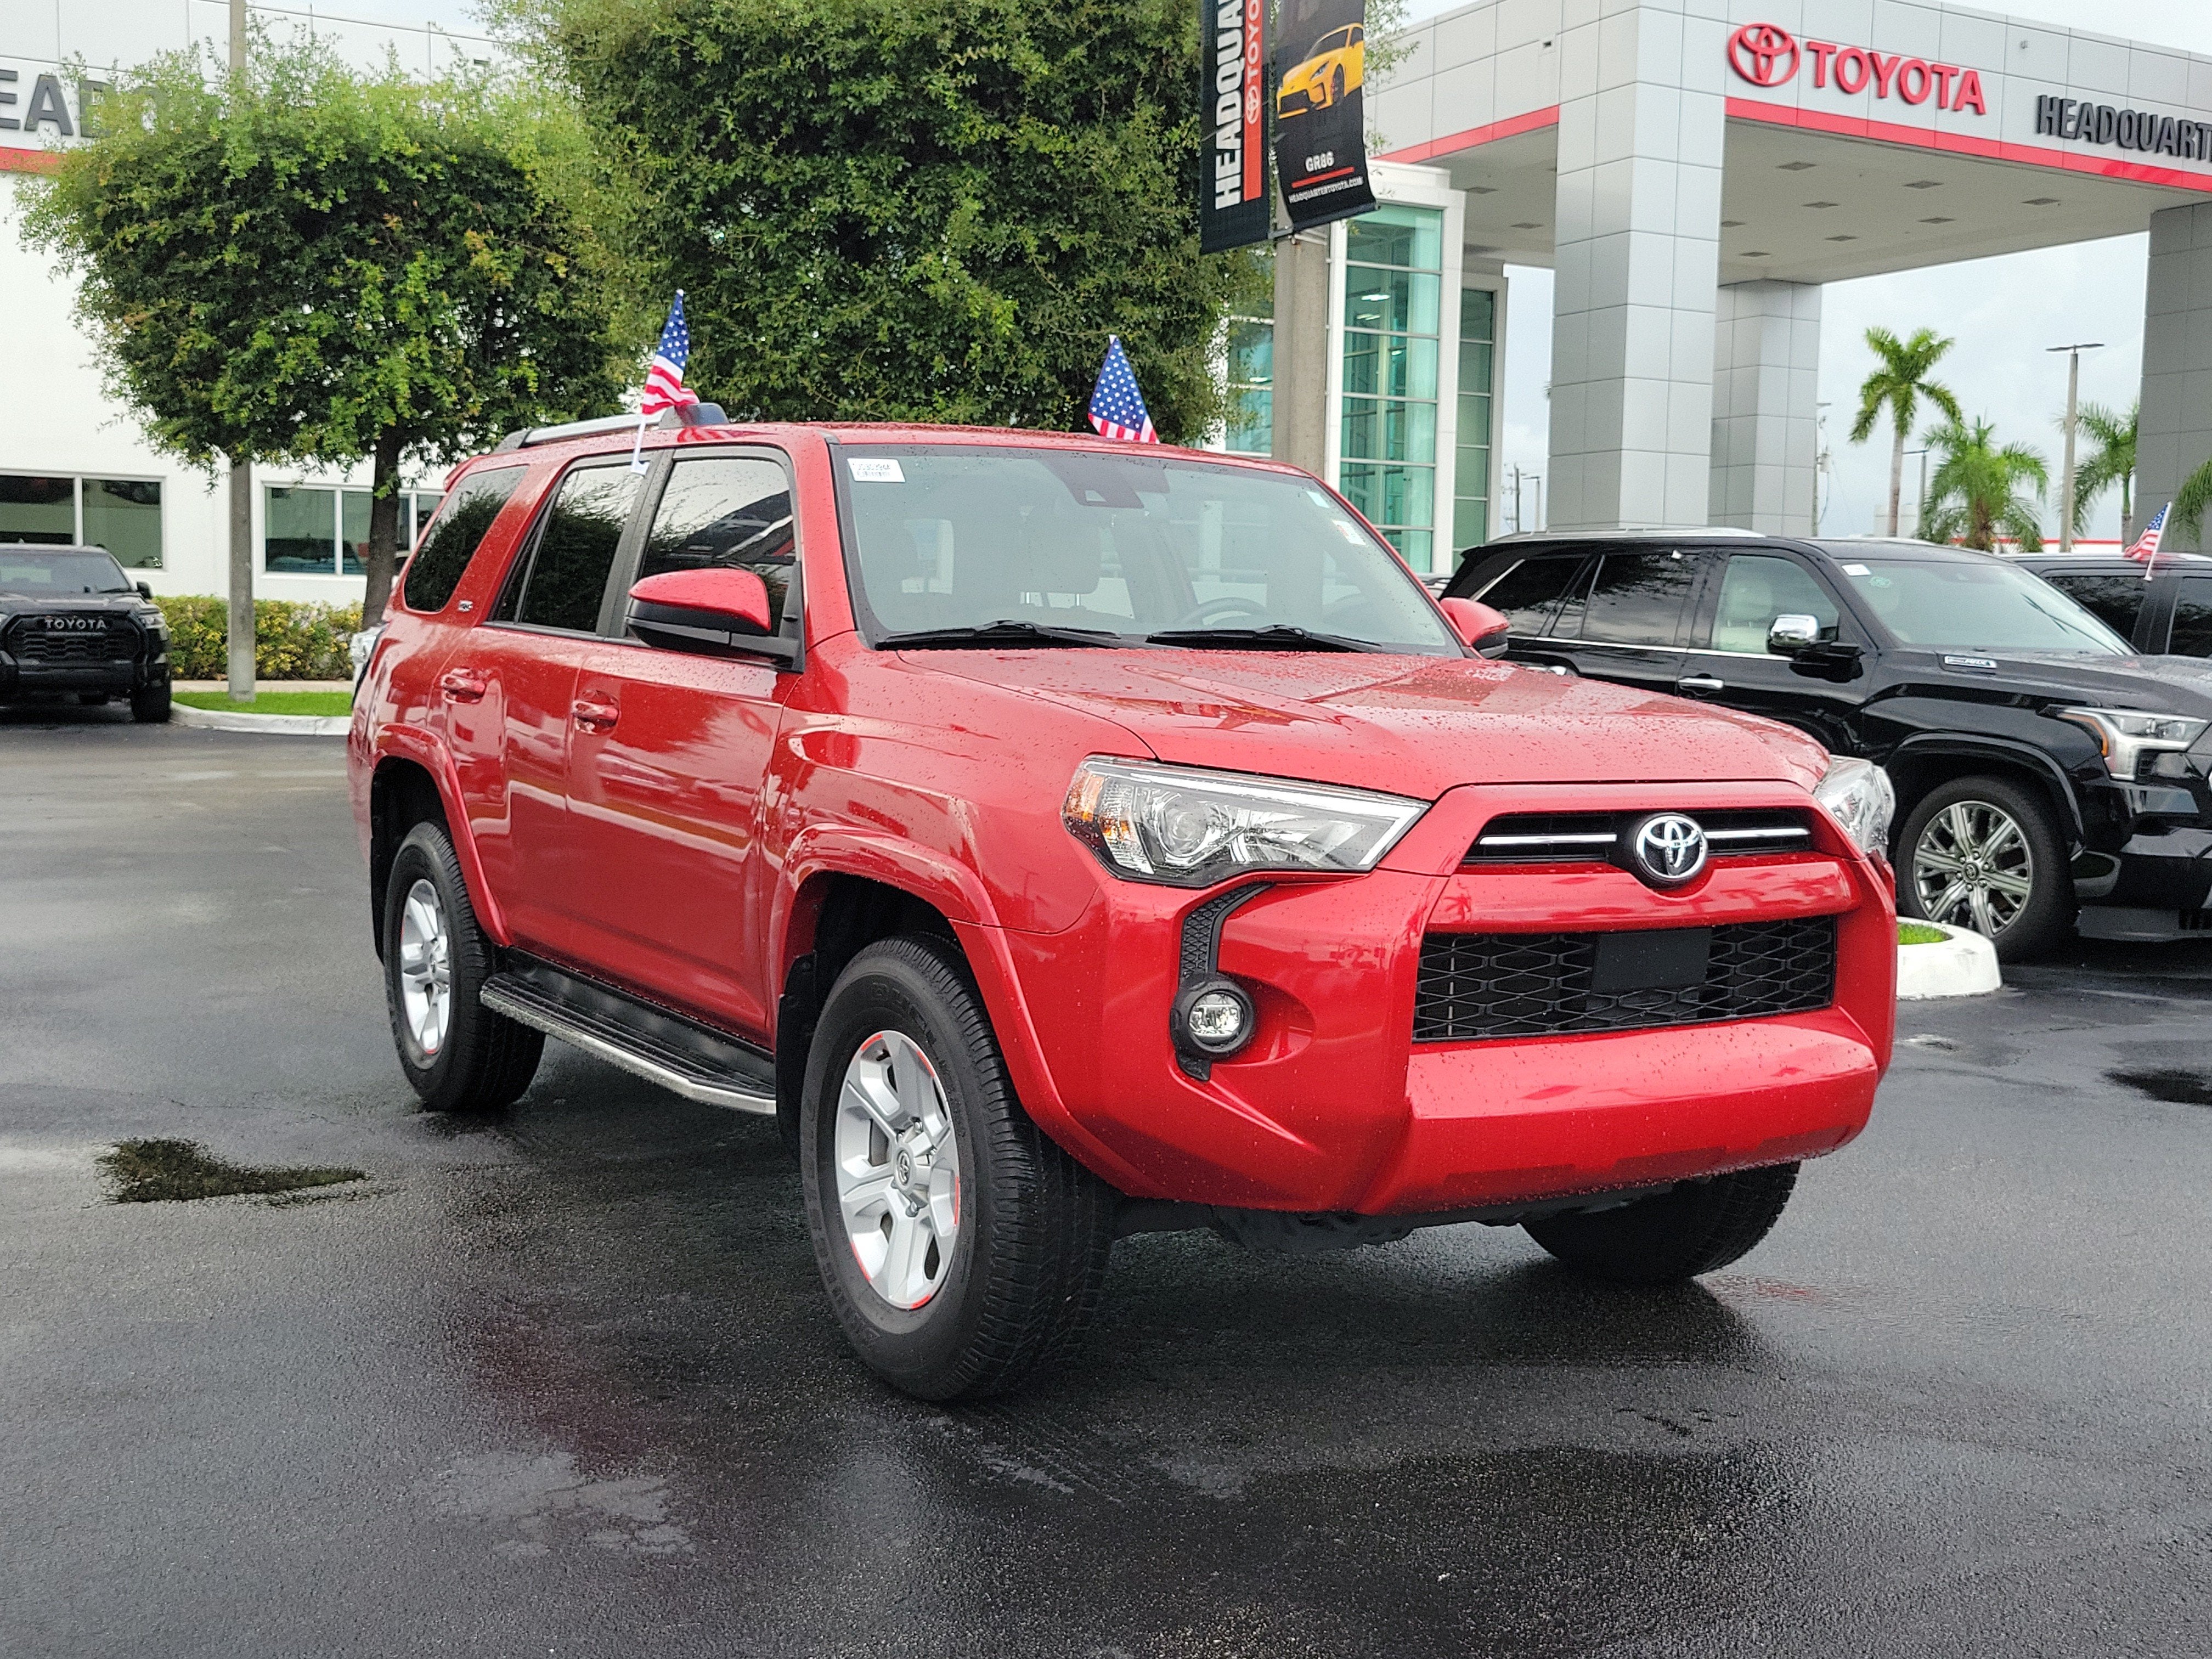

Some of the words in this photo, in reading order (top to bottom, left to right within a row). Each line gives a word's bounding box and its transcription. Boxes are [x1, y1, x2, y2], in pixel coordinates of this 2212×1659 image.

[1215, 0, 1245, 210] HEADQUA
[1807, 41, 1987, 115] TOYOTA
[2035, 95, 2212, 163] HEADQUART
[1305, 150, 1335, 172] GR86
[44, 618, 108, 630] TOYOTA
